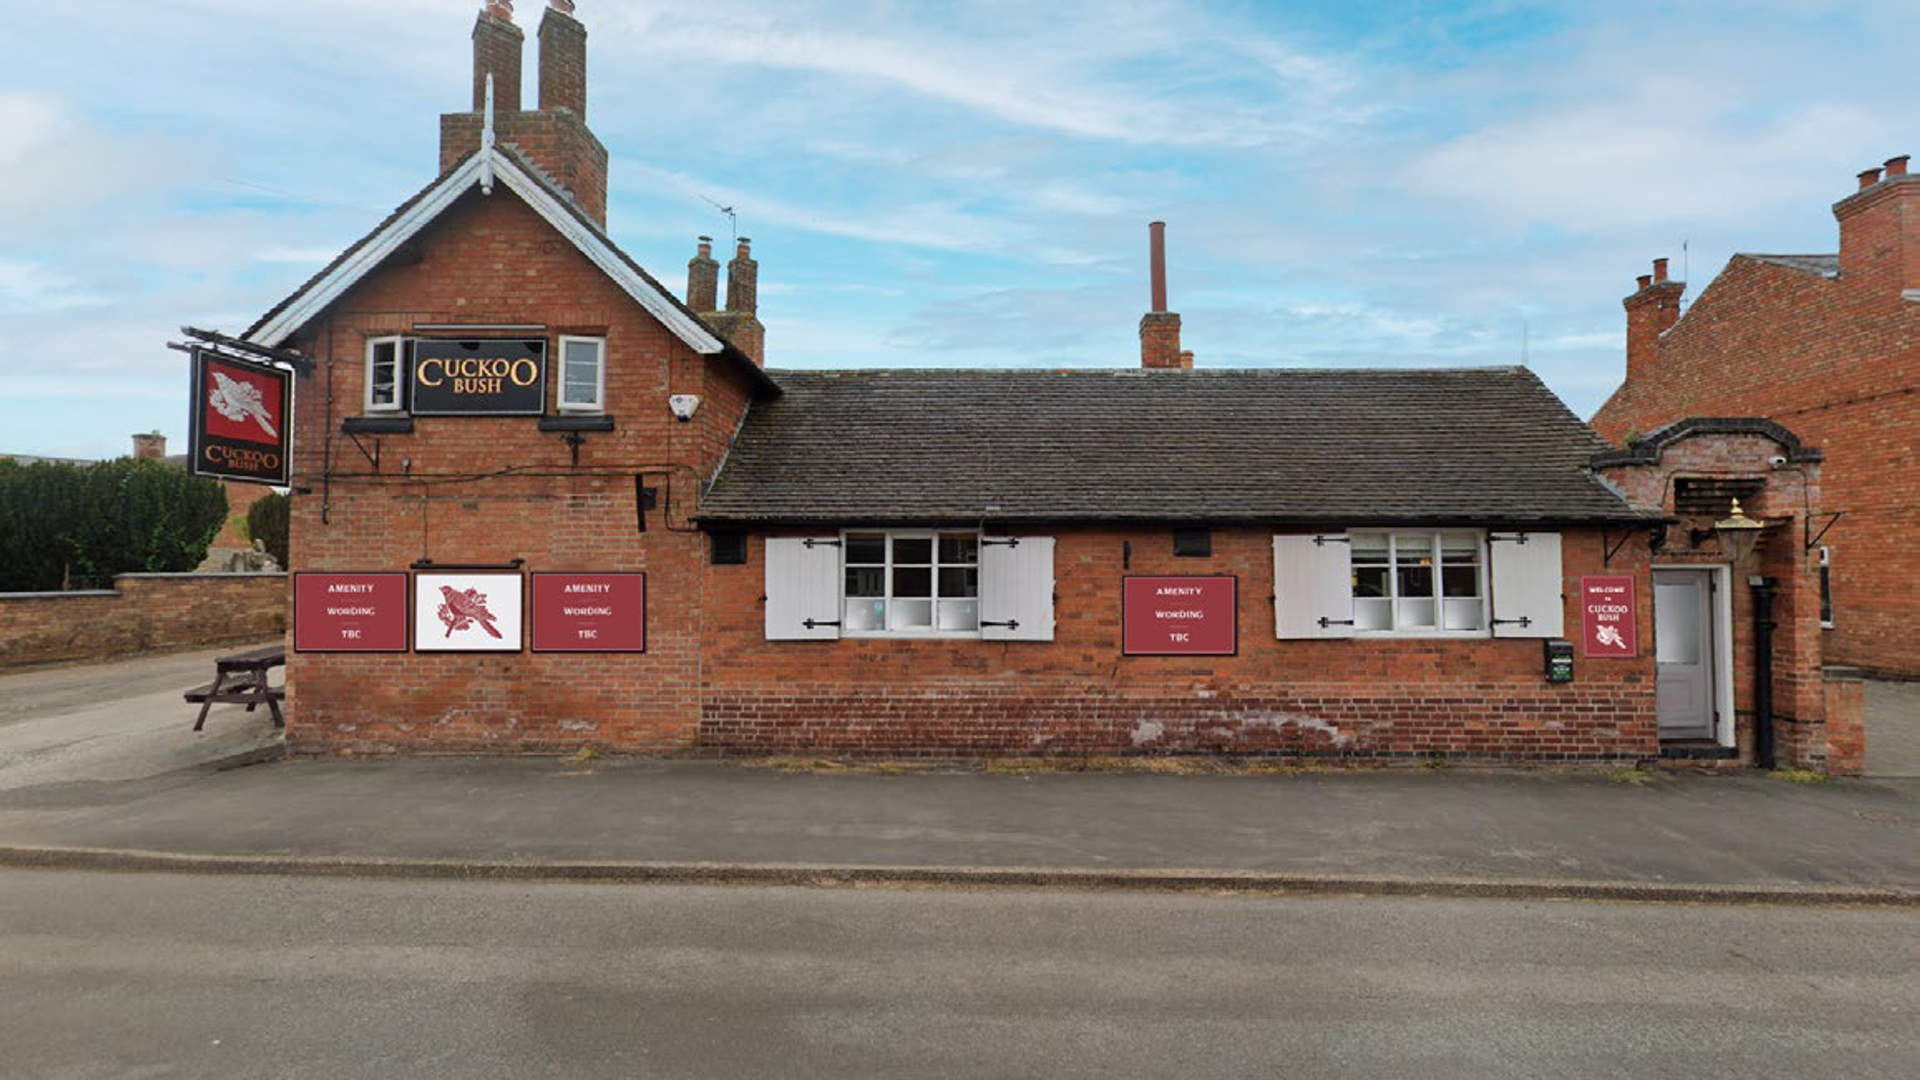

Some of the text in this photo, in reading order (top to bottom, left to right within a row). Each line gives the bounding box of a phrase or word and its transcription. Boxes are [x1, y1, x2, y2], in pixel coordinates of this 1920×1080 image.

[417, 358, 538, 386] CUCKOO
[453, 378, 503, 393] BUSH
[205, 445, 279, 469] CUCKOO
[327, 584, 374, 593] AMENITY
[564, 584, 610, 593] AMENITY
[1156, 587, 1203, 596] AMENITY
[327, 607, 375, 616] WORDING
[563, 607, 612, 616] WORDING
[1588, 604, 1628, 613] CUCKOO
[1155, 610, 1204, 619] WORDING
[341, 629, 361, 639] TBC
[578, 629, 597, 639] TBC
